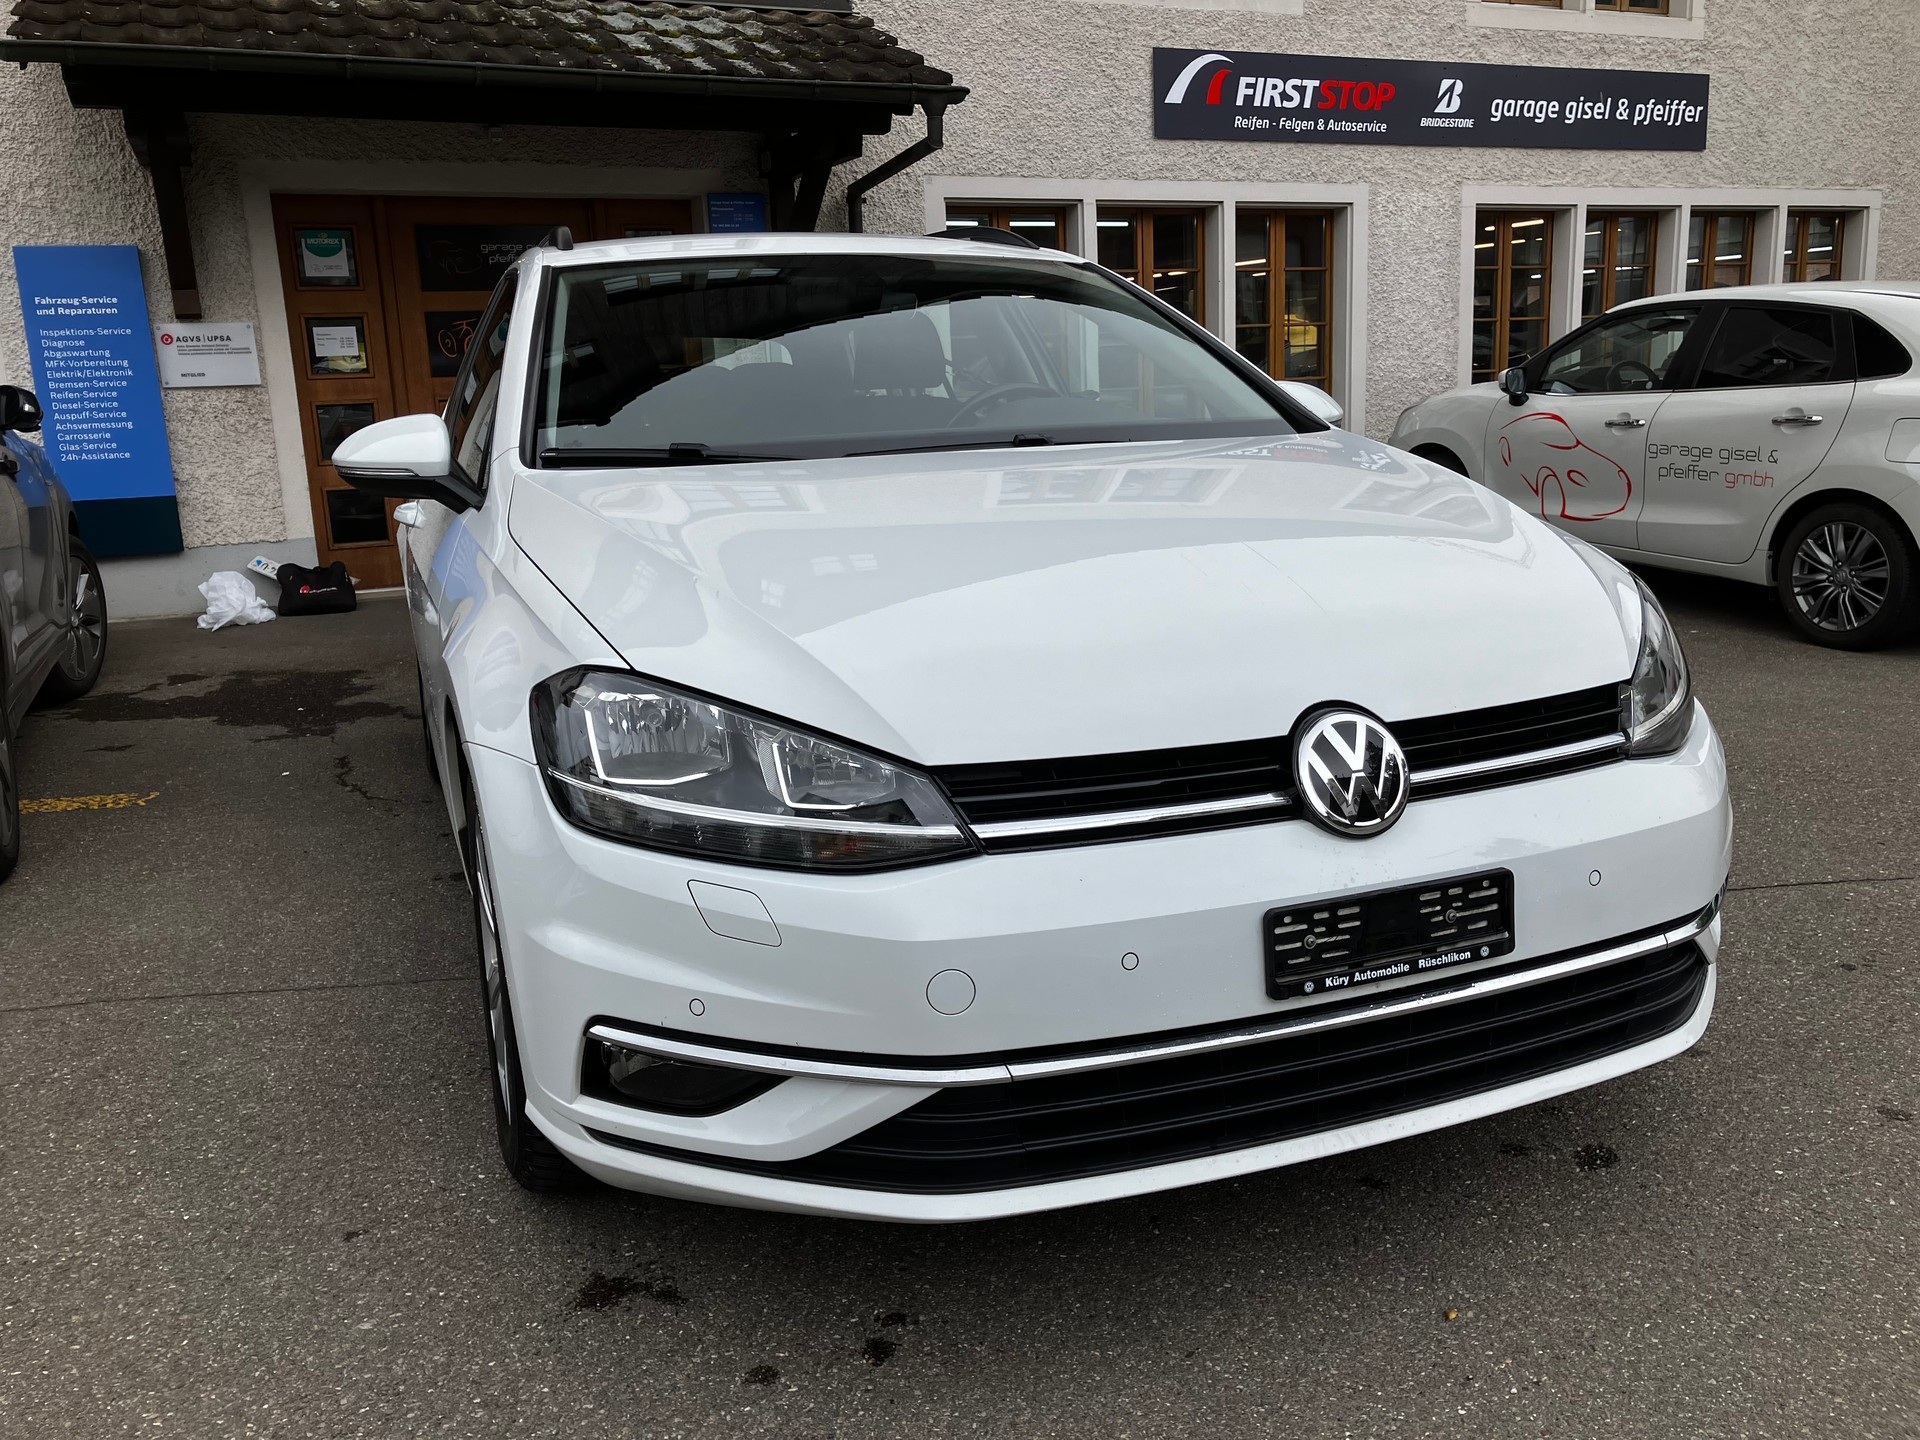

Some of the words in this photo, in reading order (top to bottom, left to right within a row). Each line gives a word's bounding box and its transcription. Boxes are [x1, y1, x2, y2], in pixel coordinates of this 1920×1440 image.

[1490, 98, 1560, 123] garage
[1564, 96, 1612, 124] gisel
[1615, 98, 1630, 121] &
[1633, 98, 1704, 126] pfeiffer
[1234, 115, 1270, 130] Reifen
[1279, 117, 1314, 132] Felgen
[1317, 119, 1325, 130] &
[1326, 119, 1387, 133] Autoservice
[1420, 117, 1475, 128] BRIDGESTONE
[480, 243, 523, 254] garage
[34, 295, 118, 306] Fahrzeug-Service
[36, 307, 55, 316] und
[57, 307, 118, 316] Reparaturen
[40, 327, 132, 338] Inspektions-Service
[41, 339, 86, 348] Diagnose
[175, 335, 201, 343] AGVS
[43, 349, 111, 359] Abgaswartung
[45, 359, 129, 368] MFK-Vorbereitung
[46, 368, 134, 379] Elektrik/Elektronik
[48, 380, 128, 389] Bremsen-Service
[50, 390, 118, 400] Reifen-Service
[52, 400, 119, 410] Diesel-Service
[53, 410, 127, 421] Auspuff-Service
[55, 421, 133, 431] Achsvermessung
[57, 431, 111, 441] Carrosserie
[58, 441, 117, 451] Glas-Service
[60, 451, 131, 462] 24h-Assistance
[1647, 443, 1713, 462] garage
[1718, 445, 1762, 465] gisel
[1767, 447, 1779, 464] &
[1658, 463, 1719, 482] pfeiffer
[1724, 471, 1775, 489] gmbh
[1325, 975, 1350, 988] Küry
[1353, 963, 1410, 982] Automobile
[1418, 951, 1471, 969] Rüschlikon
